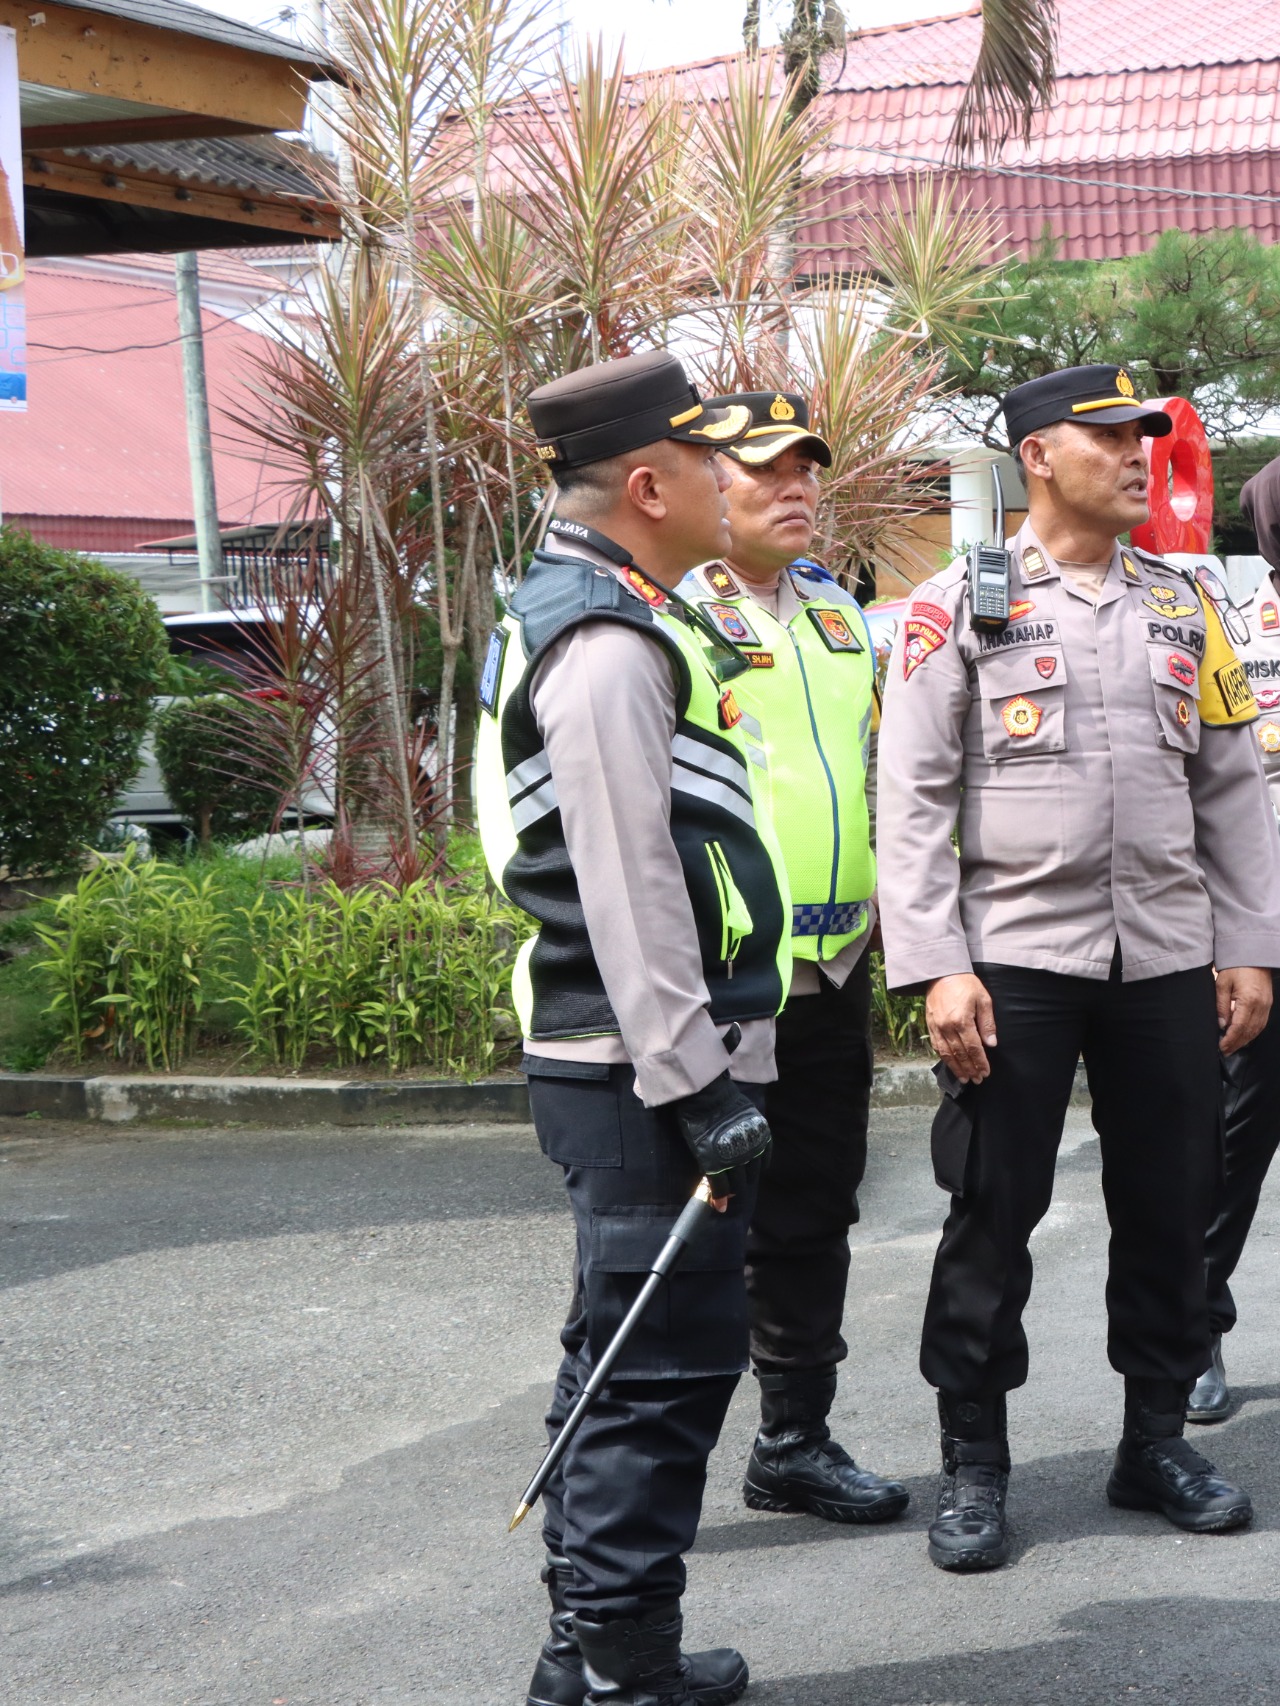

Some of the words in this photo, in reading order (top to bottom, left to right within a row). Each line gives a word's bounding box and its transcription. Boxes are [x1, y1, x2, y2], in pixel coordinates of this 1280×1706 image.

[561, 522, 589, 538] JAYA
[914, 603, 949, 627] PELOPOR
[1148, 622, 1205, 653] POLRI
